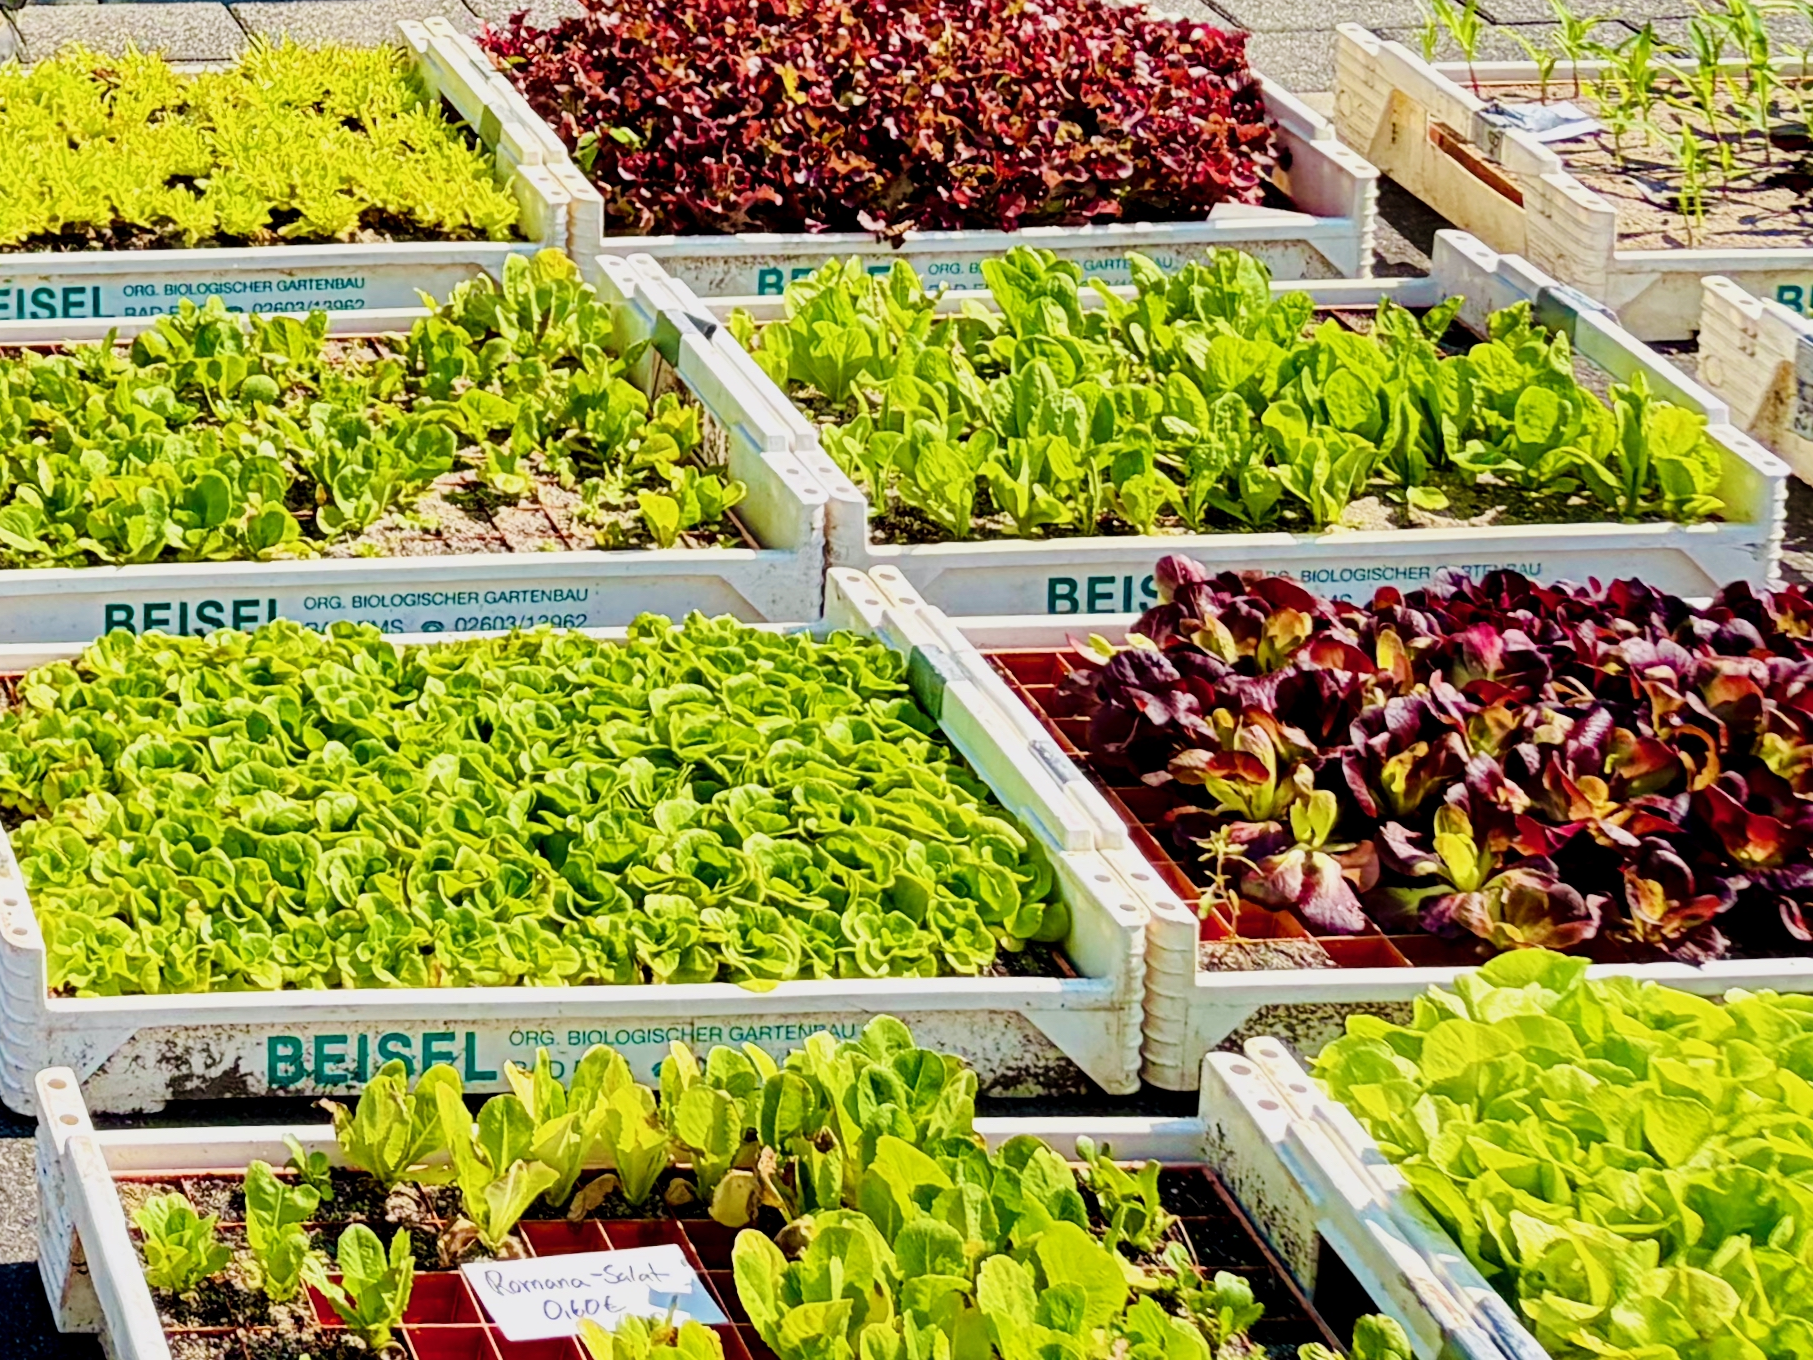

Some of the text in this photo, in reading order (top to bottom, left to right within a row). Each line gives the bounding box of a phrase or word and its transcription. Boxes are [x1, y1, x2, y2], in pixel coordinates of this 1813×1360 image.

[928, 263, 964, 275] ORG.
[1082, 256, 1173, 271] GARTEAU
[123, 277, 364, 297] ORG. BIOLOGISCHER GARTENBAU
[1301, 565, 1431, 583] BIOLOGISCHER
[303, 588, 589, 610] ORG. BIOLOGISCHER GARTENBAU
[1047, 575, 1159, 615] BEIS
[509, 1023, 857, 1047] ORG. BIOLOGISCHER GARTENBAU
[267, 1031, 497, 1084] BEISEL
[485, 1269, 583, 1296] Romana
